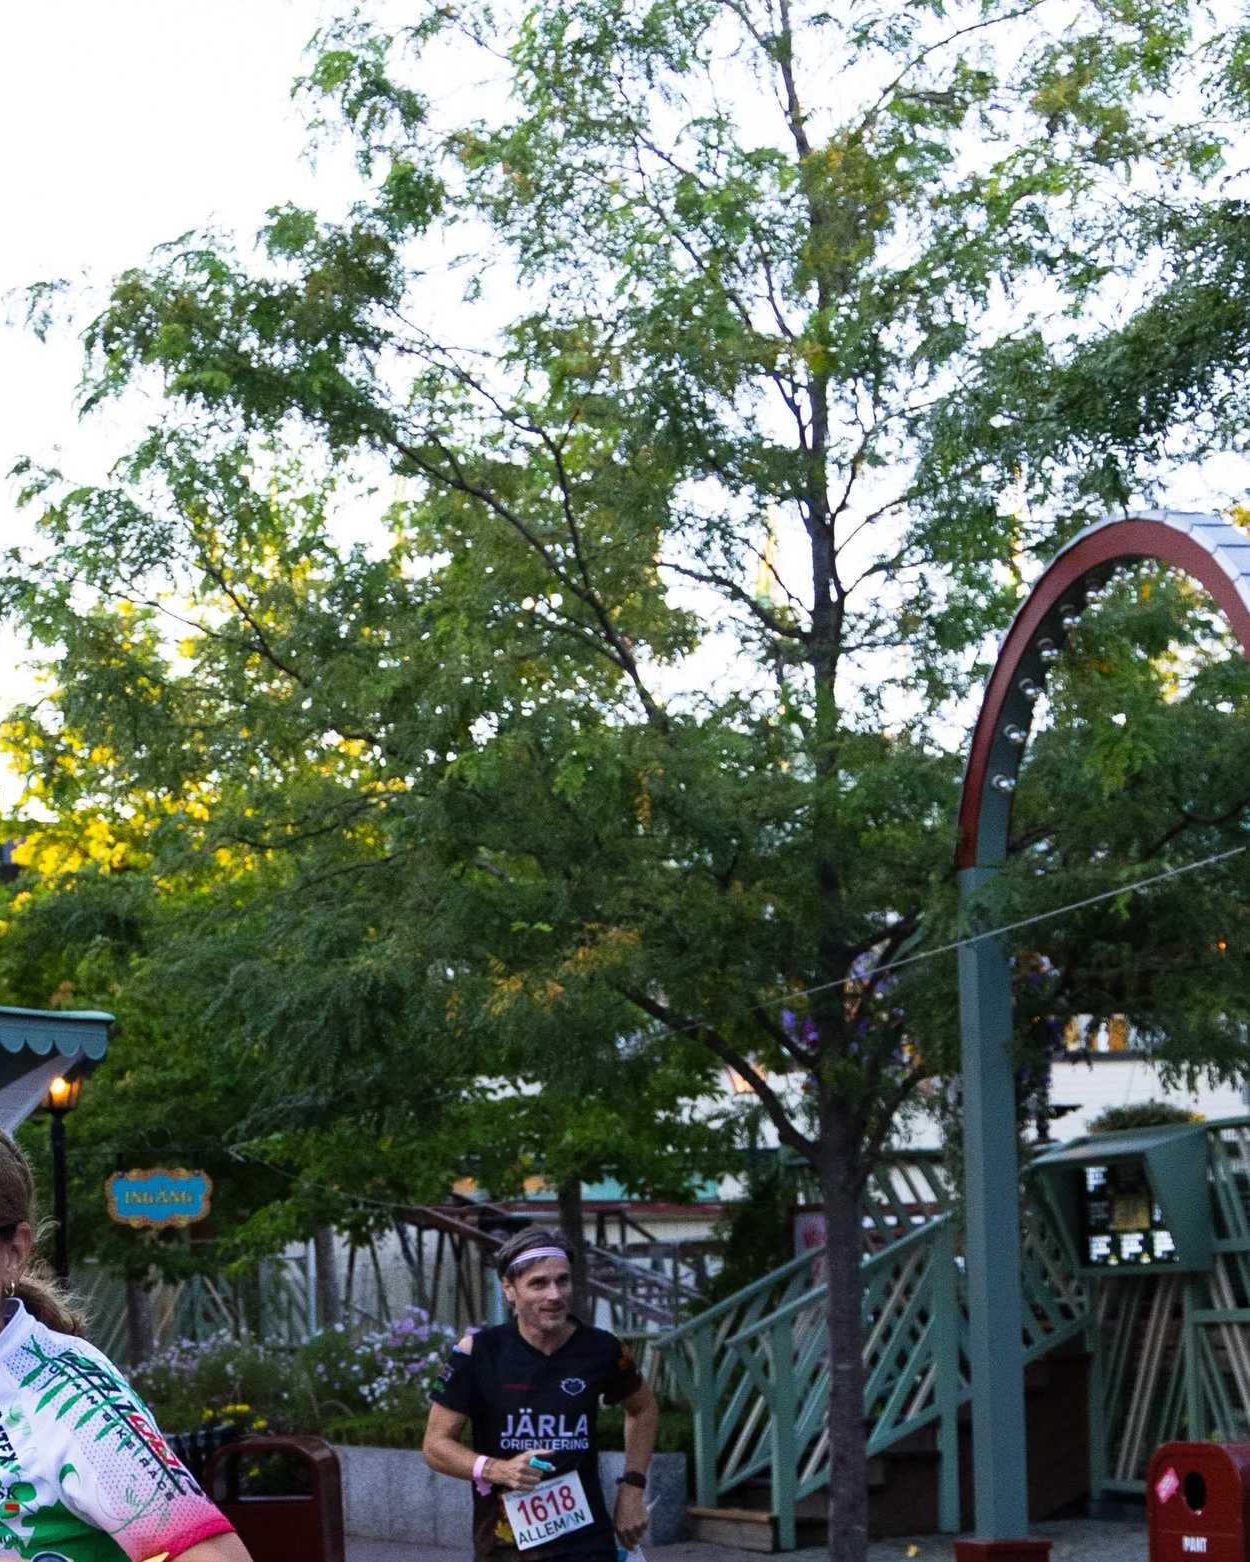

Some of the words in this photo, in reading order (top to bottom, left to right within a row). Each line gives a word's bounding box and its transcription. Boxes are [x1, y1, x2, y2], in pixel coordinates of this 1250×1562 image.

[125, 1185, 193, 1204] INGÅNG
[501, 1408, 588, 1438] JÄRLA
[500, 1438, 589, 1450] ORIENTERING
[517, 1485, 576, 1526] 1618
[1182, 1536, 1207, 1553] PANT
